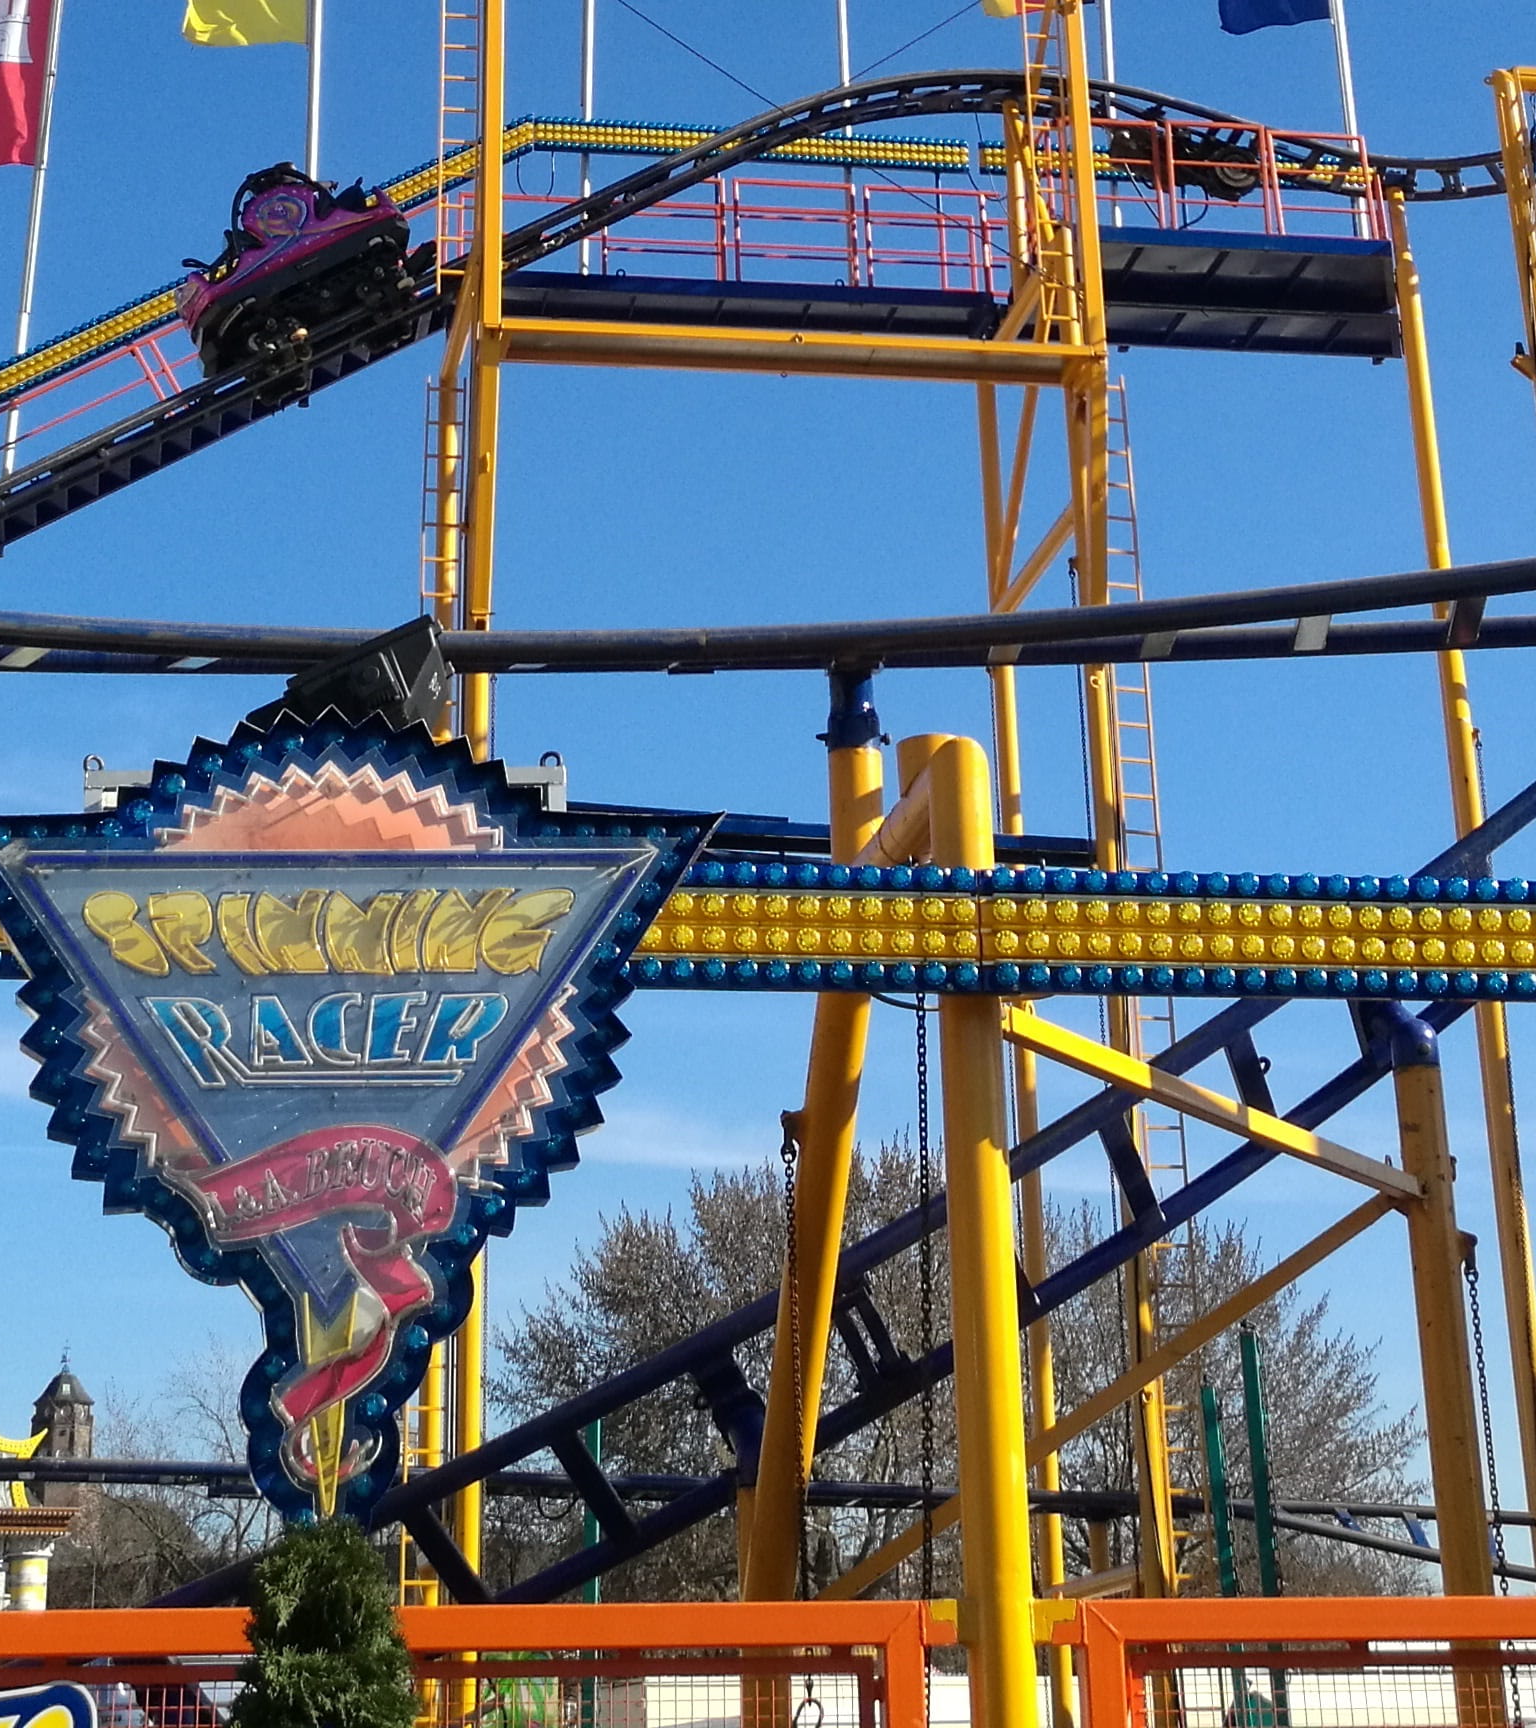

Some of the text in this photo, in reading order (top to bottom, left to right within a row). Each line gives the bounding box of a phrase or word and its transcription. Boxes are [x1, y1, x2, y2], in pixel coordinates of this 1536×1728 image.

[81, 887, 576, 976] SPINNING
[138, 990, 510, 1089] RACER
[302, 1137, 438, 1228] BRUCH
